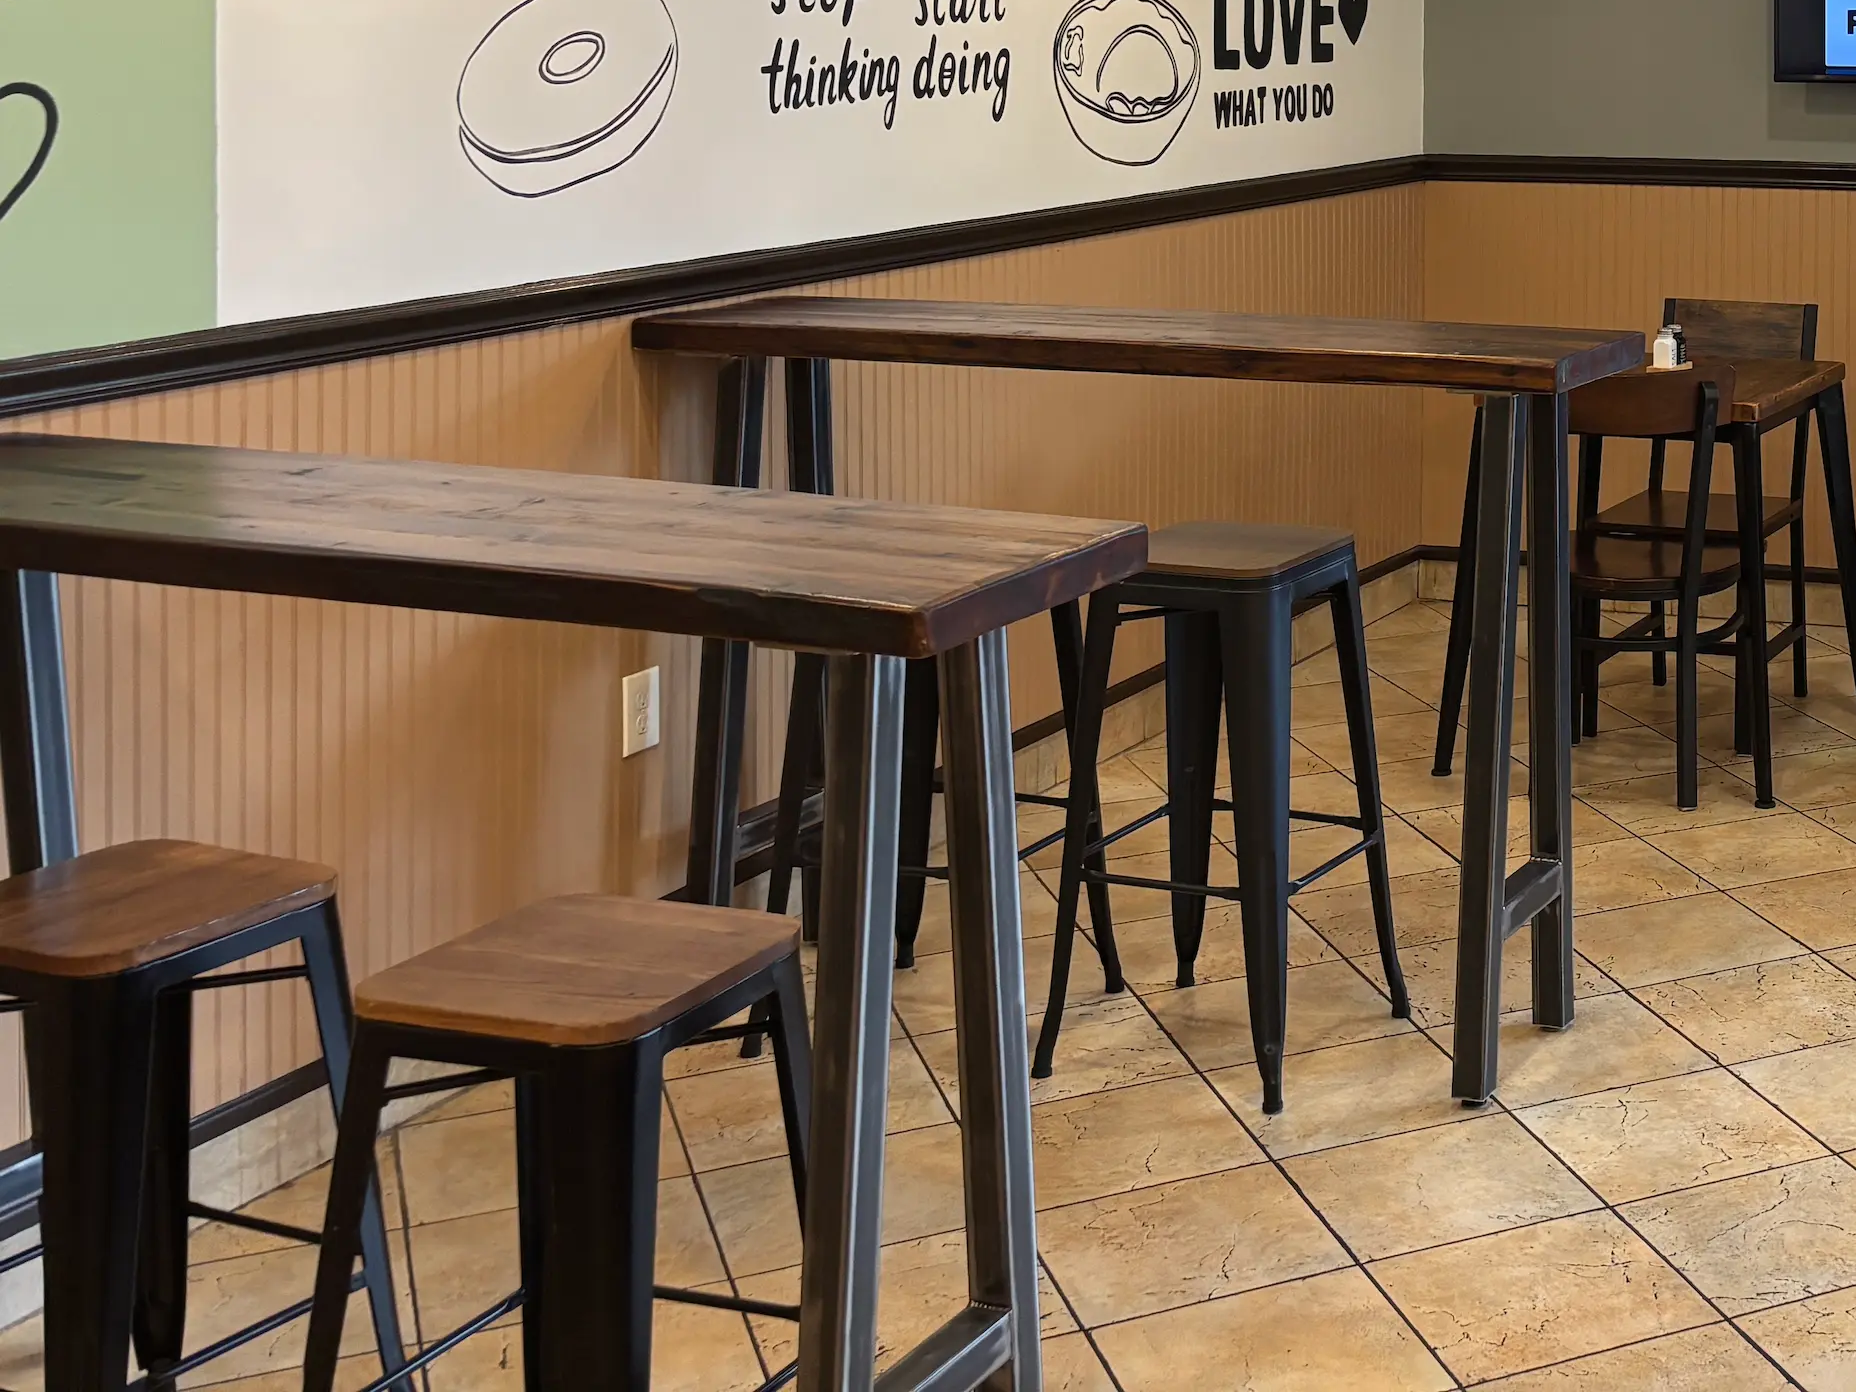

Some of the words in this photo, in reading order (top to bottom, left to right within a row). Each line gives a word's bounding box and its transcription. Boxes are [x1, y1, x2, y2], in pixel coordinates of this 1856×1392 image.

[761, 36, 902, 130] thinking
[912, 40, 1012, 123] doing
[1213, 85, 1268, 129] WHAT
[1273, 84, 1308, 124] YOU
[1310, 83, 1335, 120] DO
